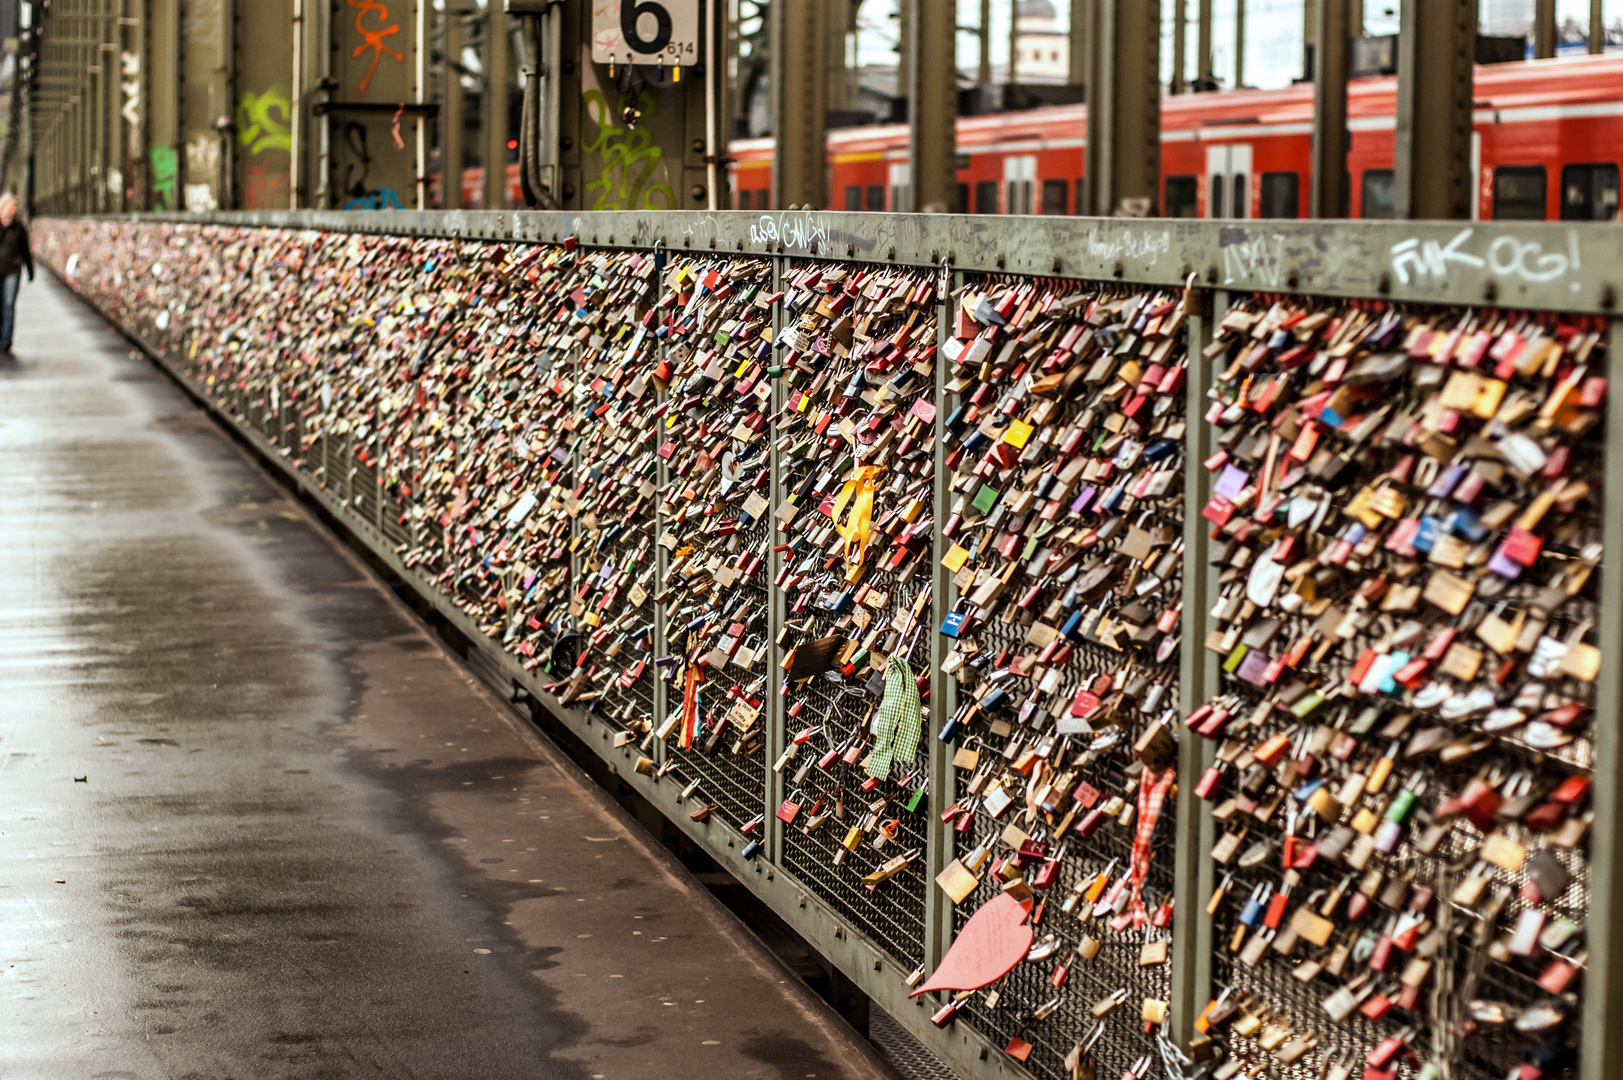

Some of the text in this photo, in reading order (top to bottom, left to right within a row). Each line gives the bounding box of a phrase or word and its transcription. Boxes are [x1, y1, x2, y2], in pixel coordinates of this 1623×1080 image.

[620, 0, 673, 54] 6
[667, 41, 694, 54] 614
[1487, 229, 1581, 292] OG!
